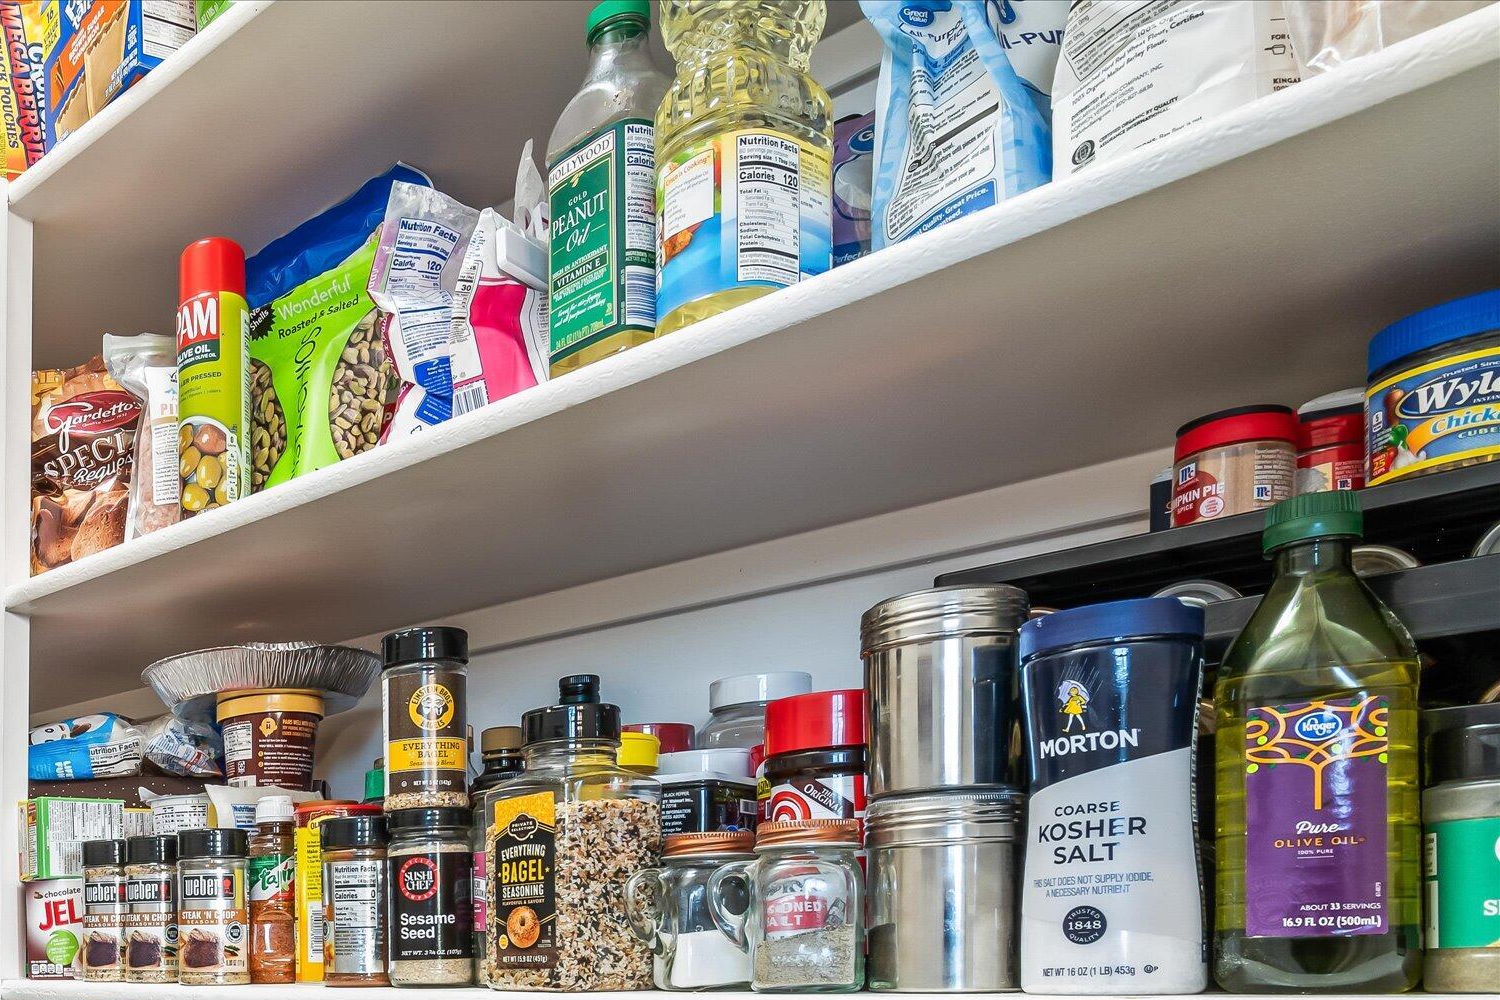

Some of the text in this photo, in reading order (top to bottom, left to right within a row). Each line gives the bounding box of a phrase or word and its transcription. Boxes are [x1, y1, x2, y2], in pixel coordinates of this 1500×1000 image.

[0, 85, 19, 149] POUCHES
[739, 136, 798, 154] Nutrition Facts
[739, 171, 799, 188] Calories 120
[568, 191, 588, 207] GOLD
[552, 190, 607, 240] PEANUT
[566, 222, 591, 253] Oil
[557, 261, 591, 288] VITAMIN
[277, 273, 351, 322] Wonderful
[278, 296, 359, 340] Roasted Salted
[190, 371, 222, 383] PRESSED
[1442, 364, 1478, 378] Trusted
[1301, 718, 1337, 737] Kroger
[402, 741, 460, 752] EVERYTHING
[1040, 728, 1139, 760] MORTON
[1054, 801, 1120, 817] COARSE
[1038, 816, 1147, 843] KOSHER
[1295, 820, 1341, 835] Pure
[1274, 836, 1358, 849] OLIVE OIL
[501, 843, 546, 863] EVERYTHING
[1053, 842, 1120, 865] SALT
[334, 864, 377, 874] Nutrition Facts
[405, 871, 434, 882] SUSHI
[501, 859, 544, 884] BAGEL
[406, 880, 433, 891] CHEF
[1058, 873, 1124, 886] DOES NOT SUPPLY
[44, 887, 81, 899] chocolate
[334, 892, 358, 901] Calories
[502, 883, 545, 898] SEASONING
[1051, 884, 1131, 897] NECESSARY NUTRIENT
[1300, 902, 1382, 912] ABOUT 33 SERVINGS
[181, 911, 201, 920] STEAK
[400, 912, 455, 926] Sesame
[1282, 914, 1382, 929] 16.9 FL OZ (500mL)
[1068, 918, 1102, 931] 1848
[400, 926, 436, 940] Seed
[1042, 965, 1136, 978] NET 453g
